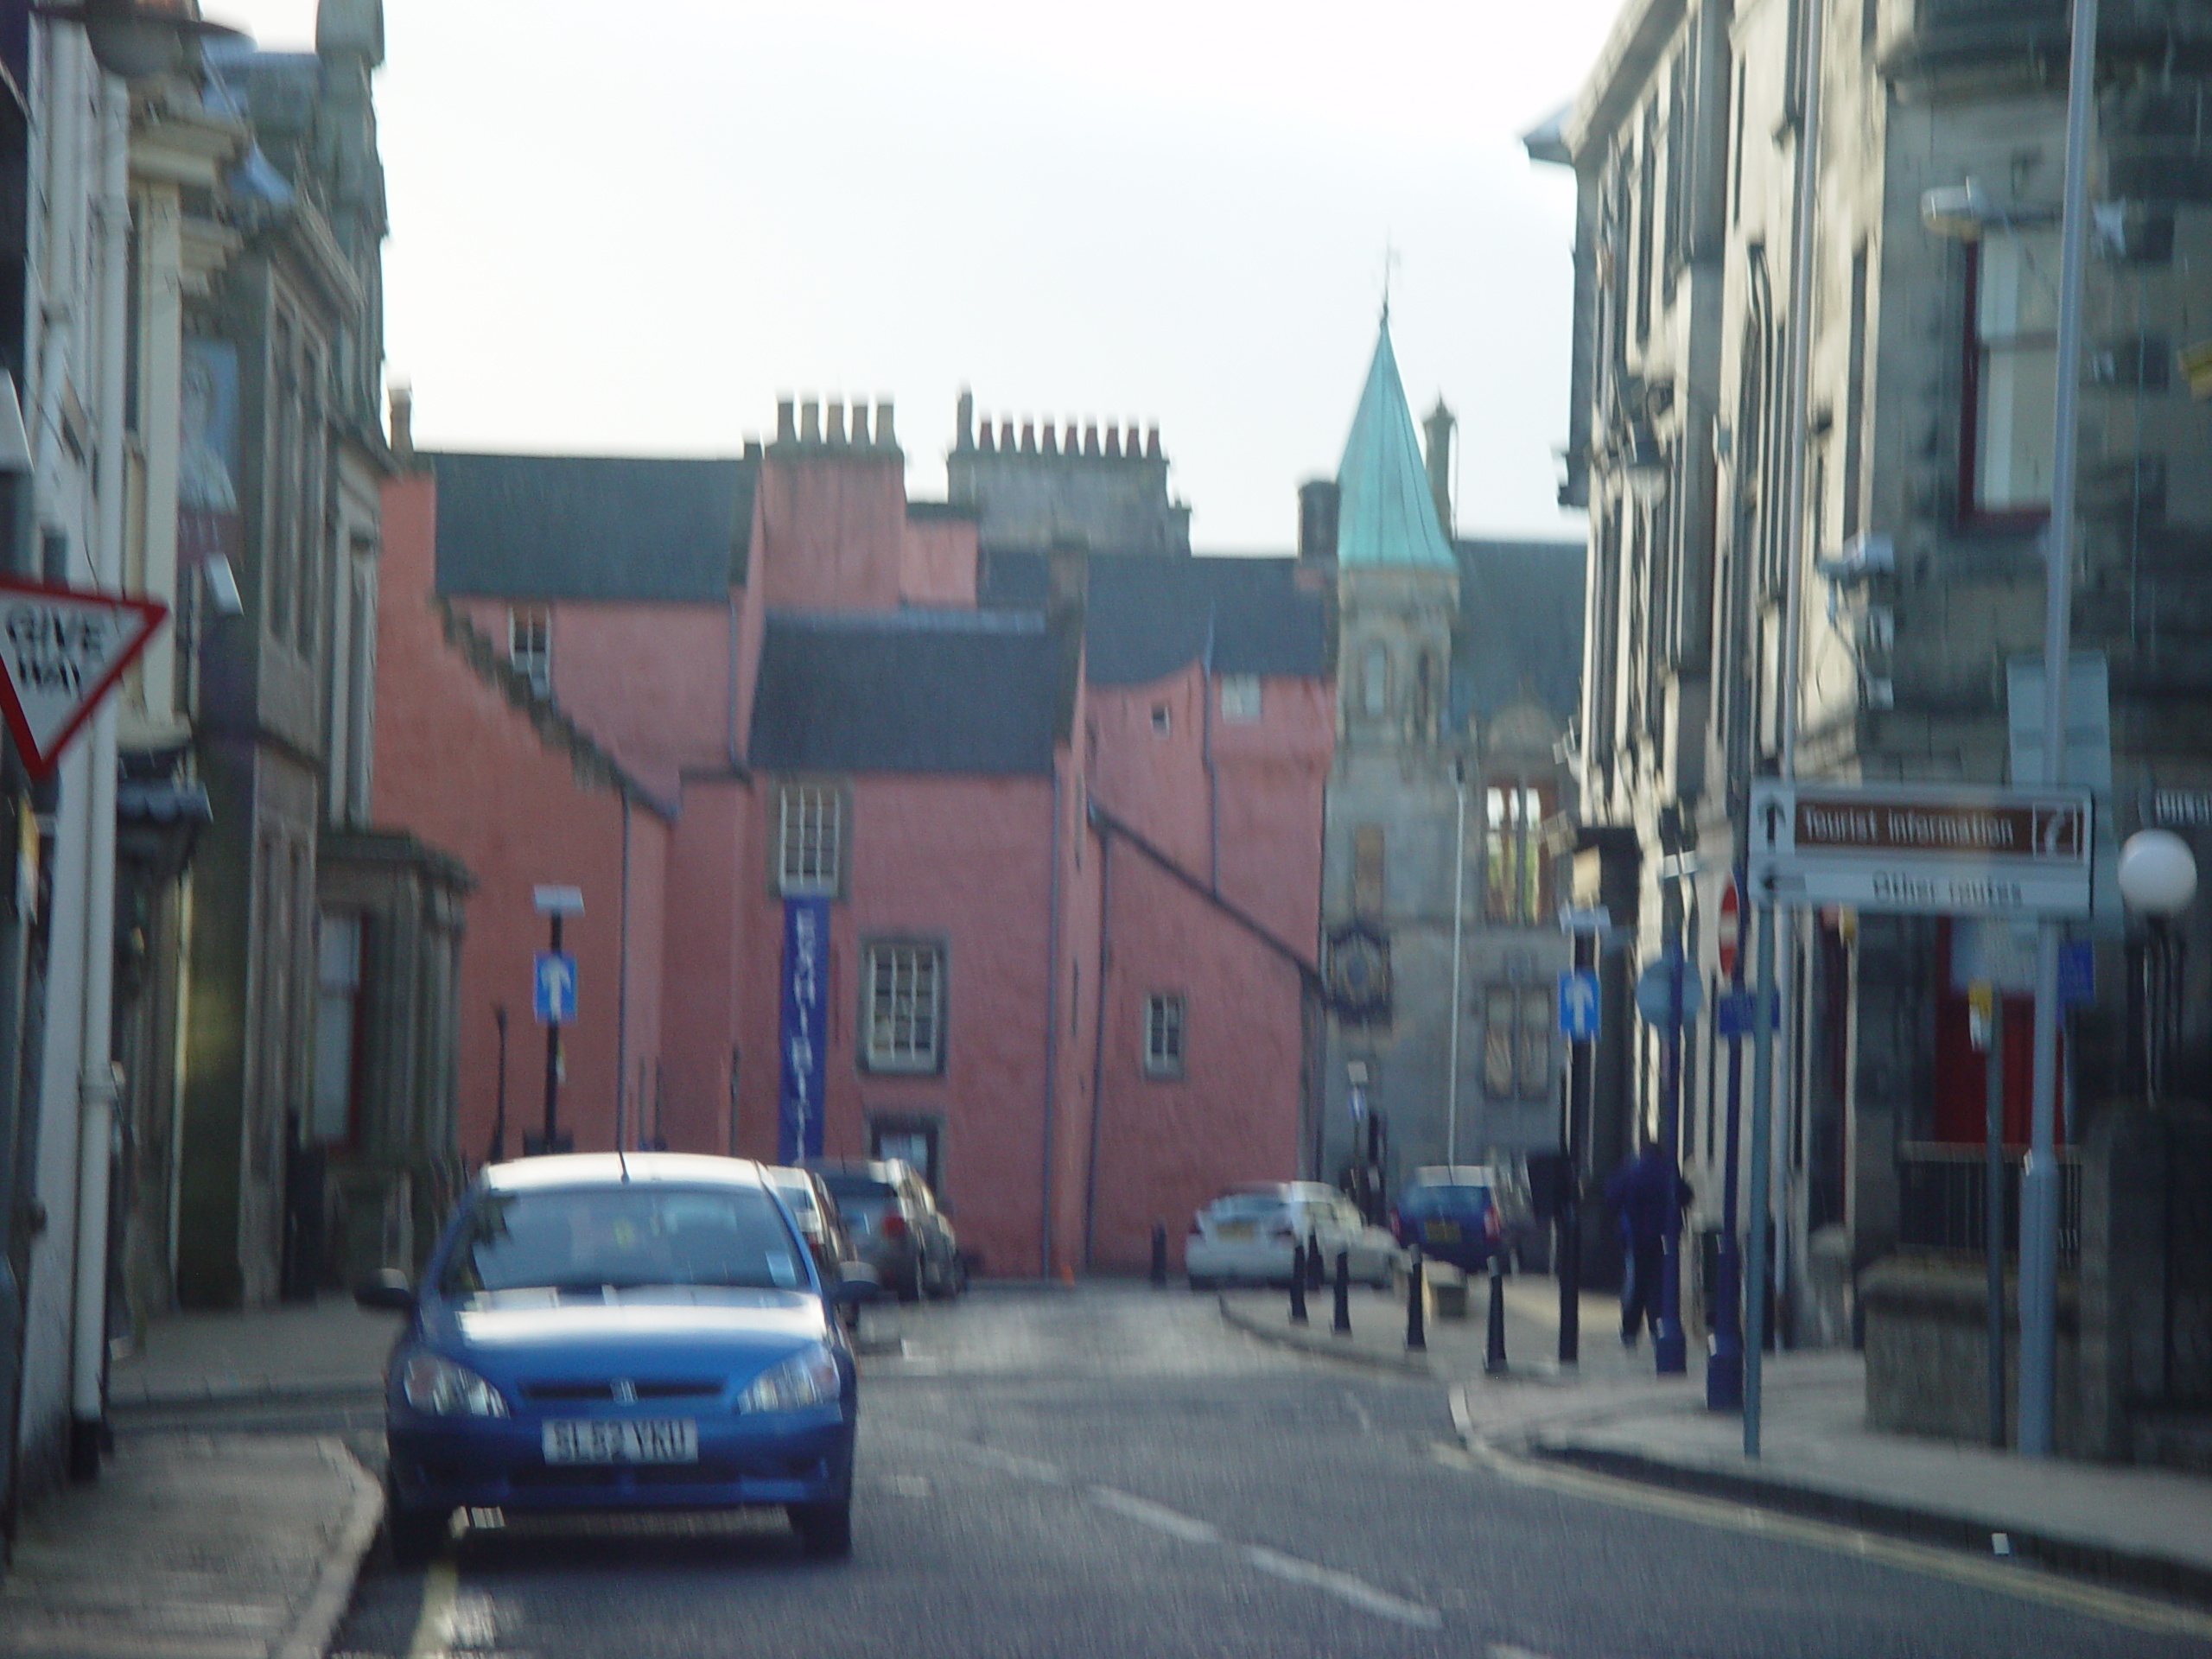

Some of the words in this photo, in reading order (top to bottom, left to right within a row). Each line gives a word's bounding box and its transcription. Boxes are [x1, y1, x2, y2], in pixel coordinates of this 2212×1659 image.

[5, 607, 106, 661] GIVE
[1803, 804, 1877, 843] Tourist
[1888, 806, 2014, 848] Information
[1872, 869, 1936, 906] Other
[1948, 873, 2023, 909] routes
